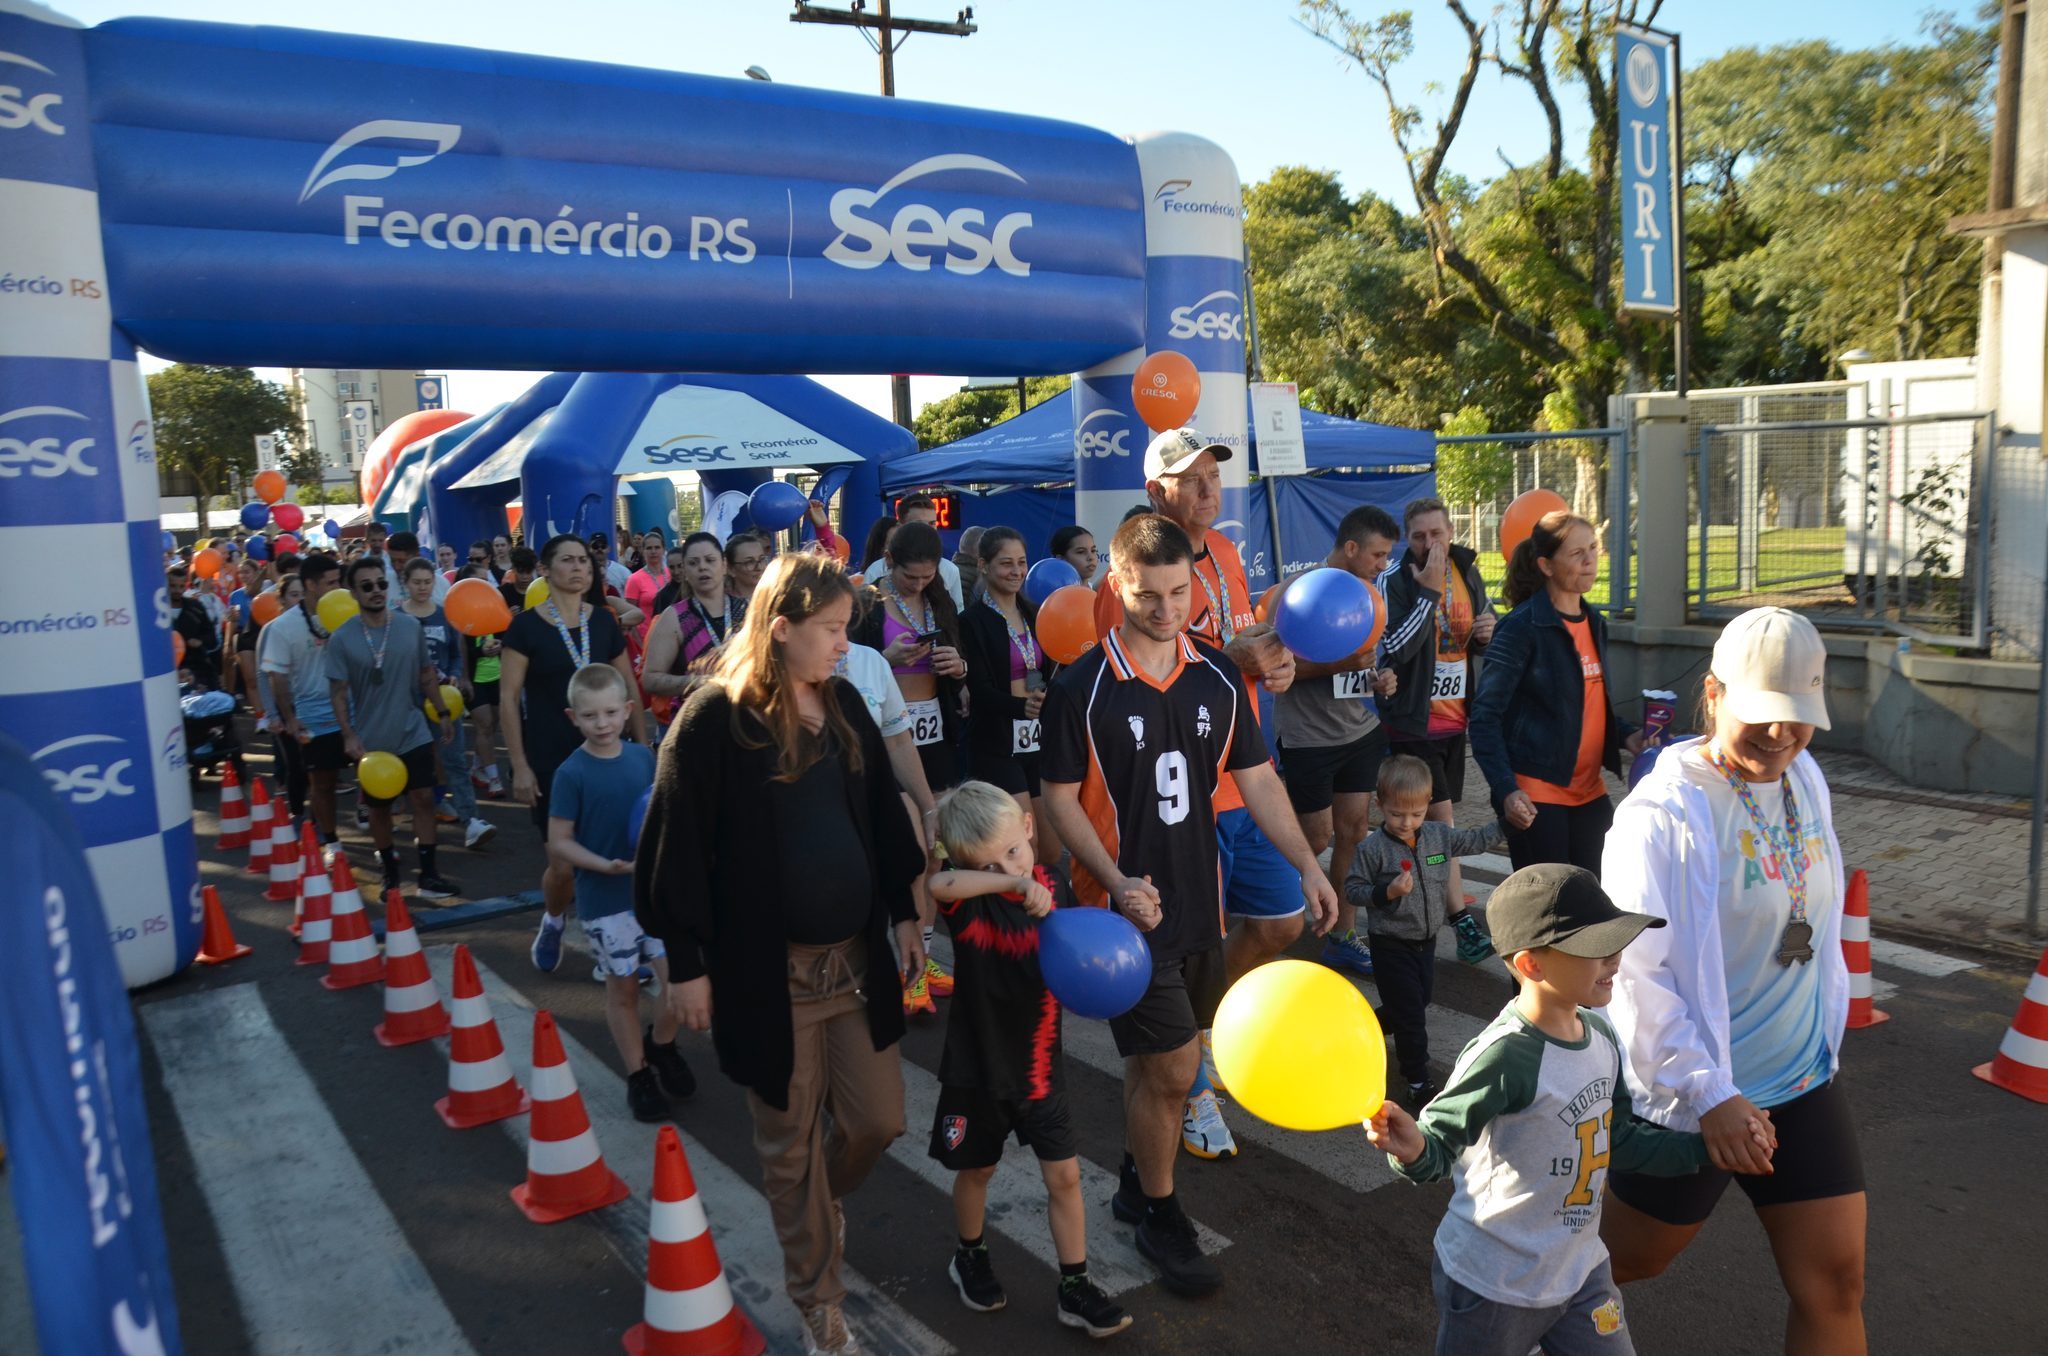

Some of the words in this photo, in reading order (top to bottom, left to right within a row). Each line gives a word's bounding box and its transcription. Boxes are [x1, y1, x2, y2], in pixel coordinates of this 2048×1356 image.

[1164, 200, 1235, 217] Fecomércio
[1630, 120, 1661, 299] URI
[344, 195, 672, 259] Fecomércio
[689, 216, 757, 264] RS
[822, 186, 1033, 277] Sesc
[69, 278, 103, 300] RS
[1168, 306, 1242, 342] Sesc
[1141, 388, 1179, 400] CRESOL
[741, 437, 818, 449] Fecomércio
[643, 445, 735, 464] Sesc
[104, 607, 131, 628] RS
[1340, 673, 1368, 695] 721
[909, 715, 938, 741] 62
[1155, 750, 1190, 826] 9
[143, 915, 168, 935] RS
[1549, 1157, 1574, 1177] 19
